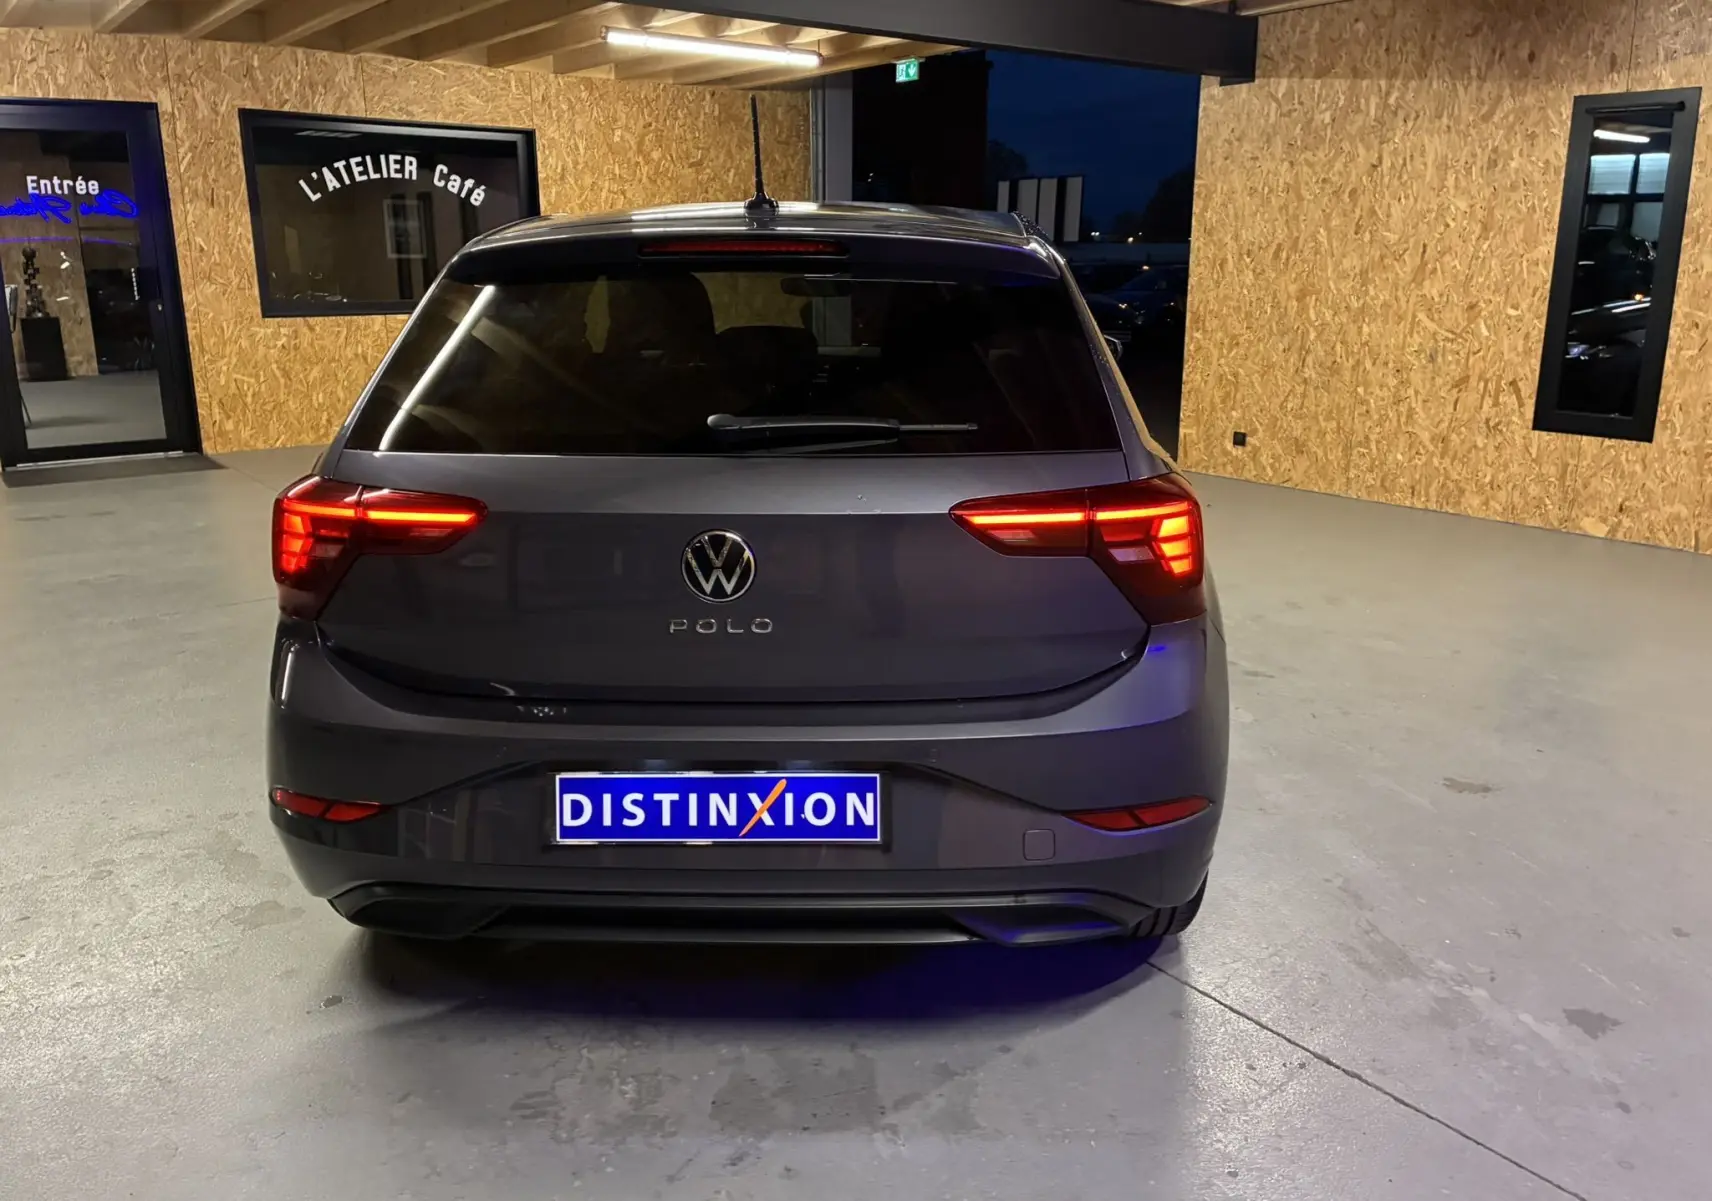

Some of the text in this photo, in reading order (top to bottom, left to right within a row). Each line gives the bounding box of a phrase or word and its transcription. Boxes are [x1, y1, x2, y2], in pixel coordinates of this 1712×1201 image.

[26, 175, 100, 195] Entrée
[298, 154, 487, 207] L'ATELIER Café
[669, 618, 773, 634] POLO
[562, 778, 875, 837] DISTINXION
